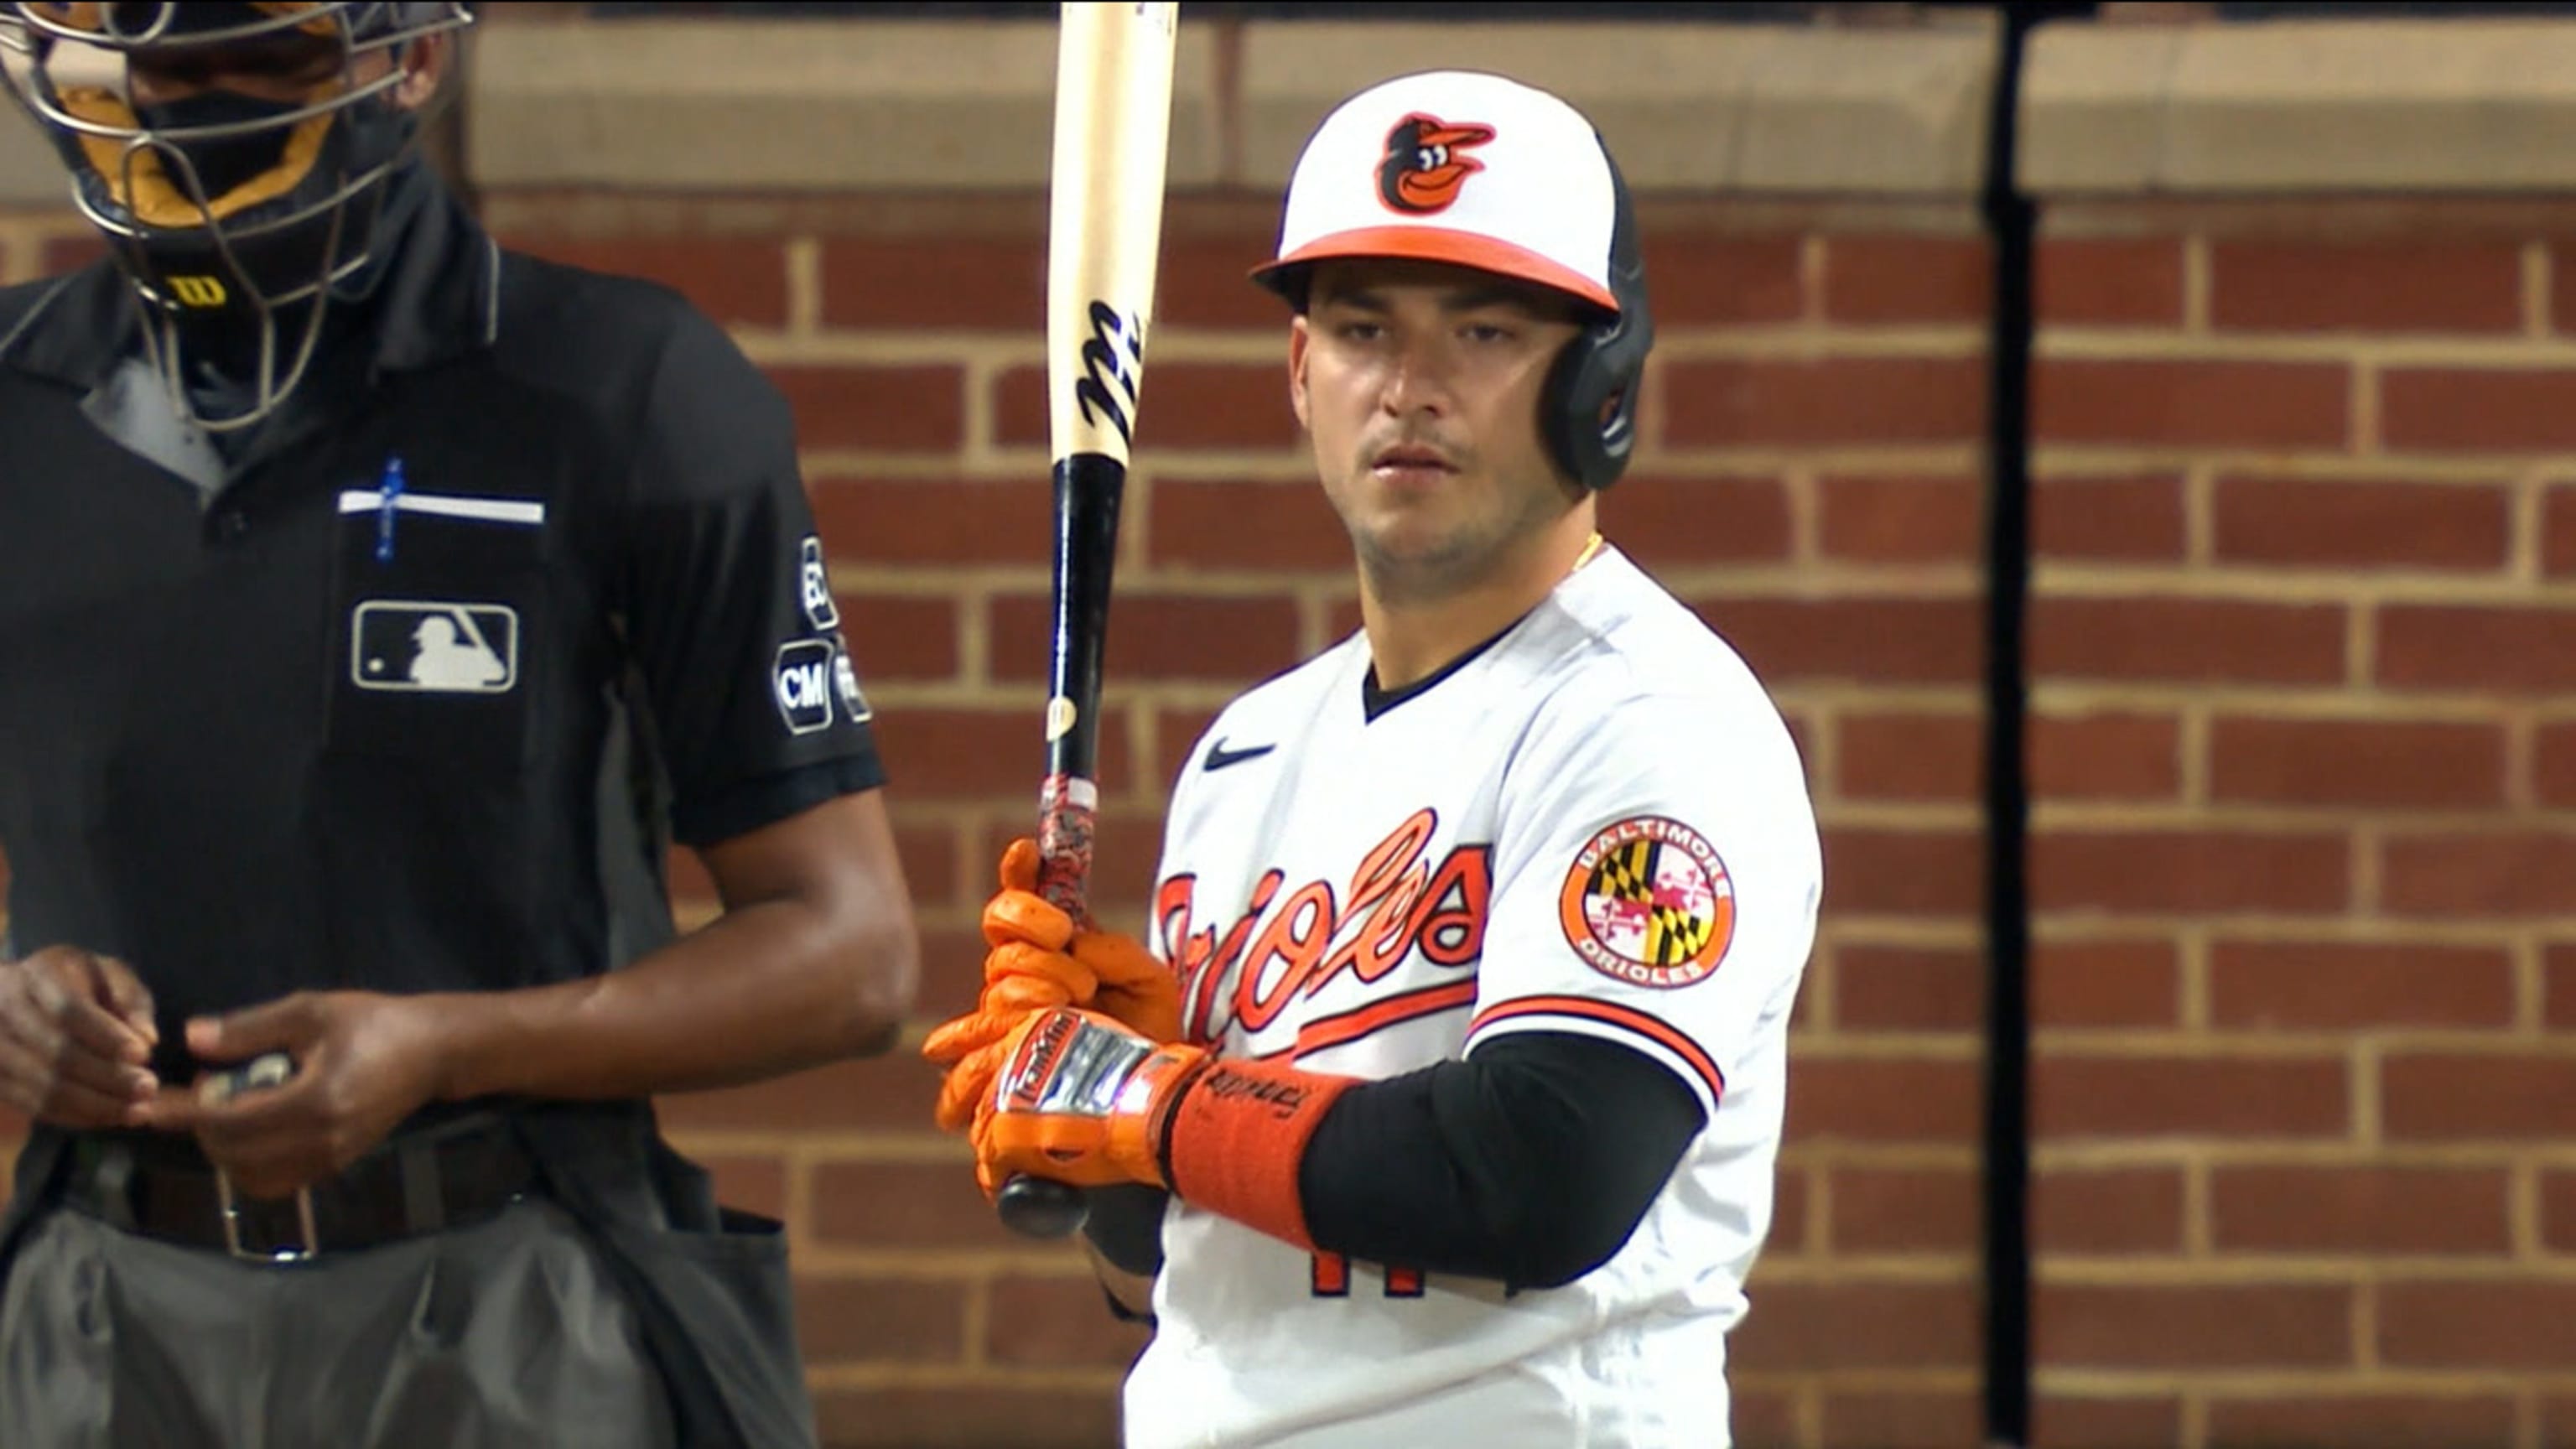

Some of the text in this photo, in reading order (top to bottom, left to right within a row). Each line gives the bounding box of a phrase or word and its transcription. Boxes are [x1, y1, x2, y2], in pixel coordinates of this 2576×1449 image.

[780, 662, 824, 709] CM
[1578, 818, 1729, 899] BALTIMORE
[1578, 936, 1706, 984] ORIOLES
